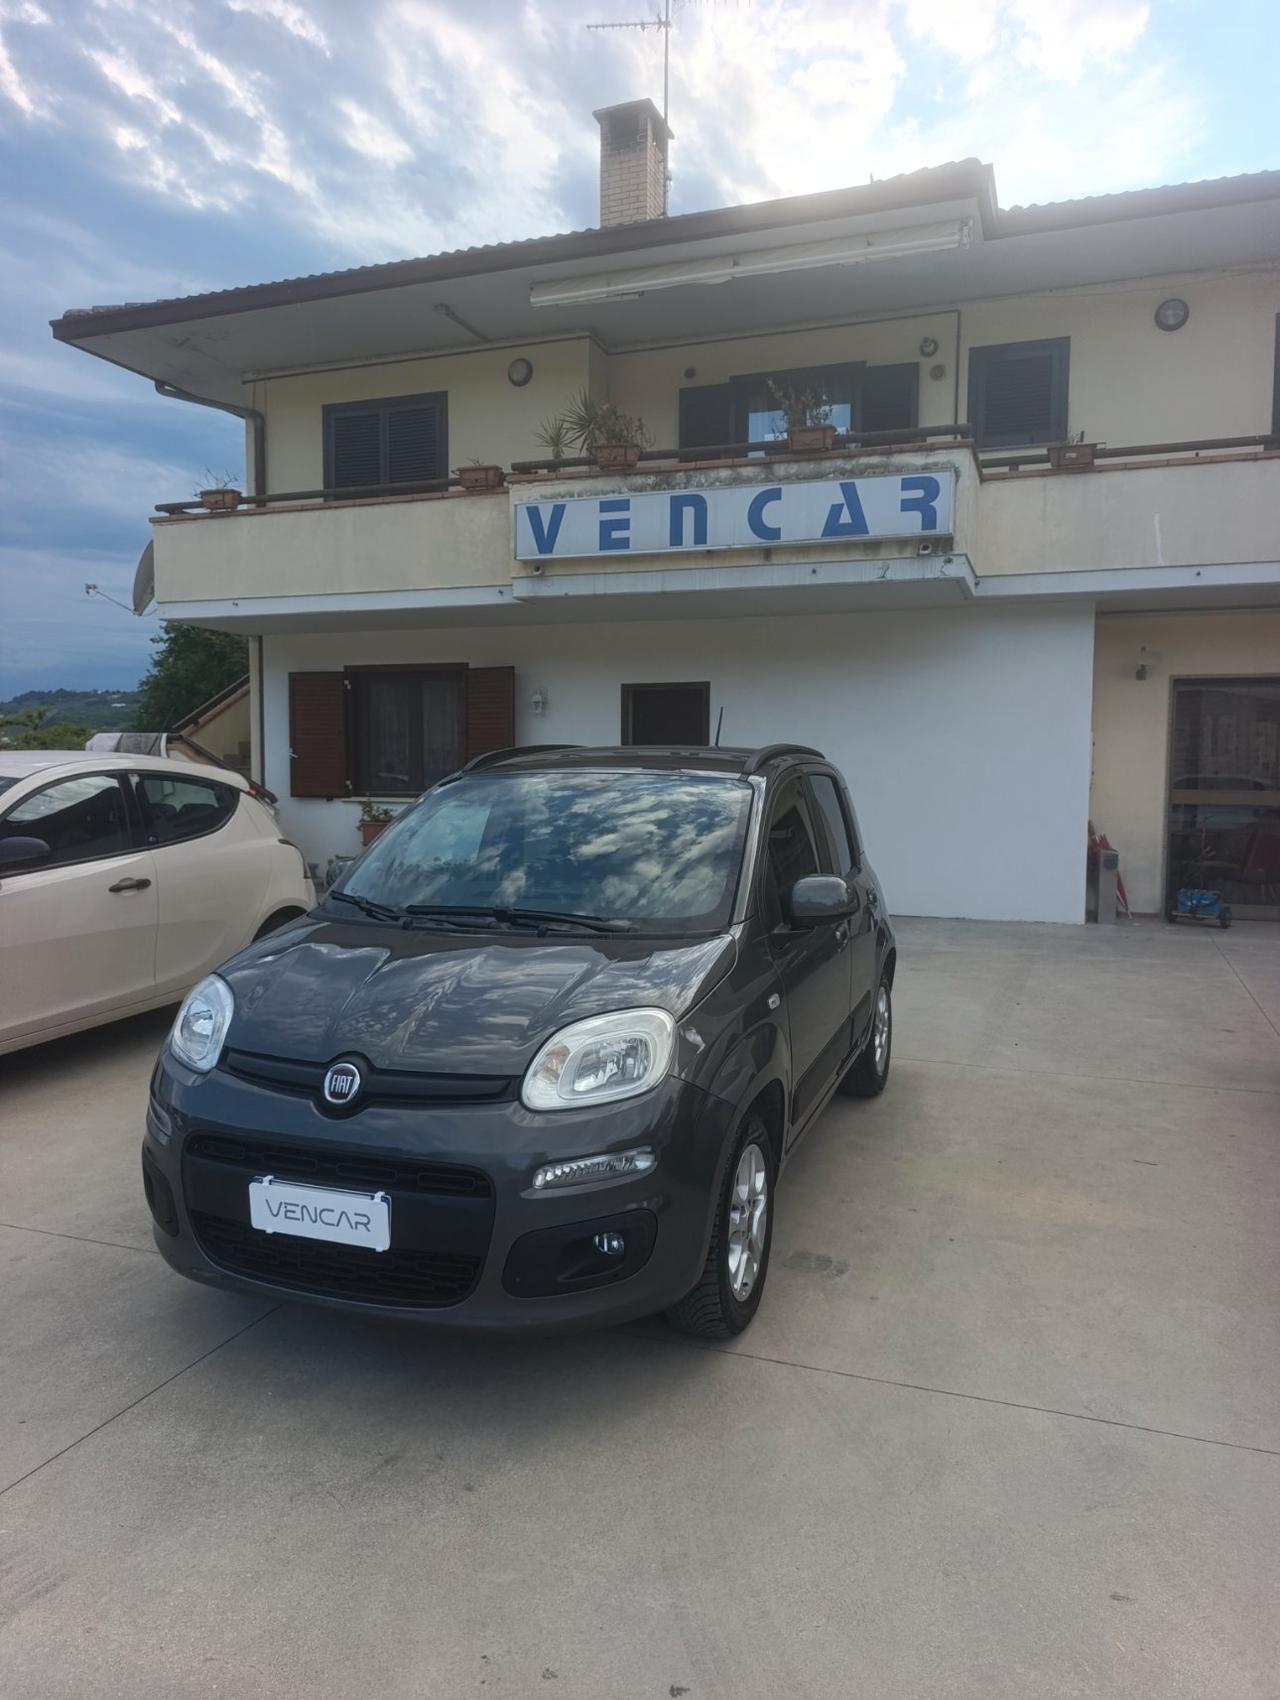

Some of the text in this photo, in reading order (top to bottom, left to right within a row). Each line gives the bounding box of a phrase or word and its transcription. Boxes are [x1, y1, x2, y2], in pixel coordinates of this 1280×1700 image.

[525, 476, 941, 554] VENCAR
[330, 1074, 353, 1094] FIAT
[265, 1199, 371, 1232] VENCAR
